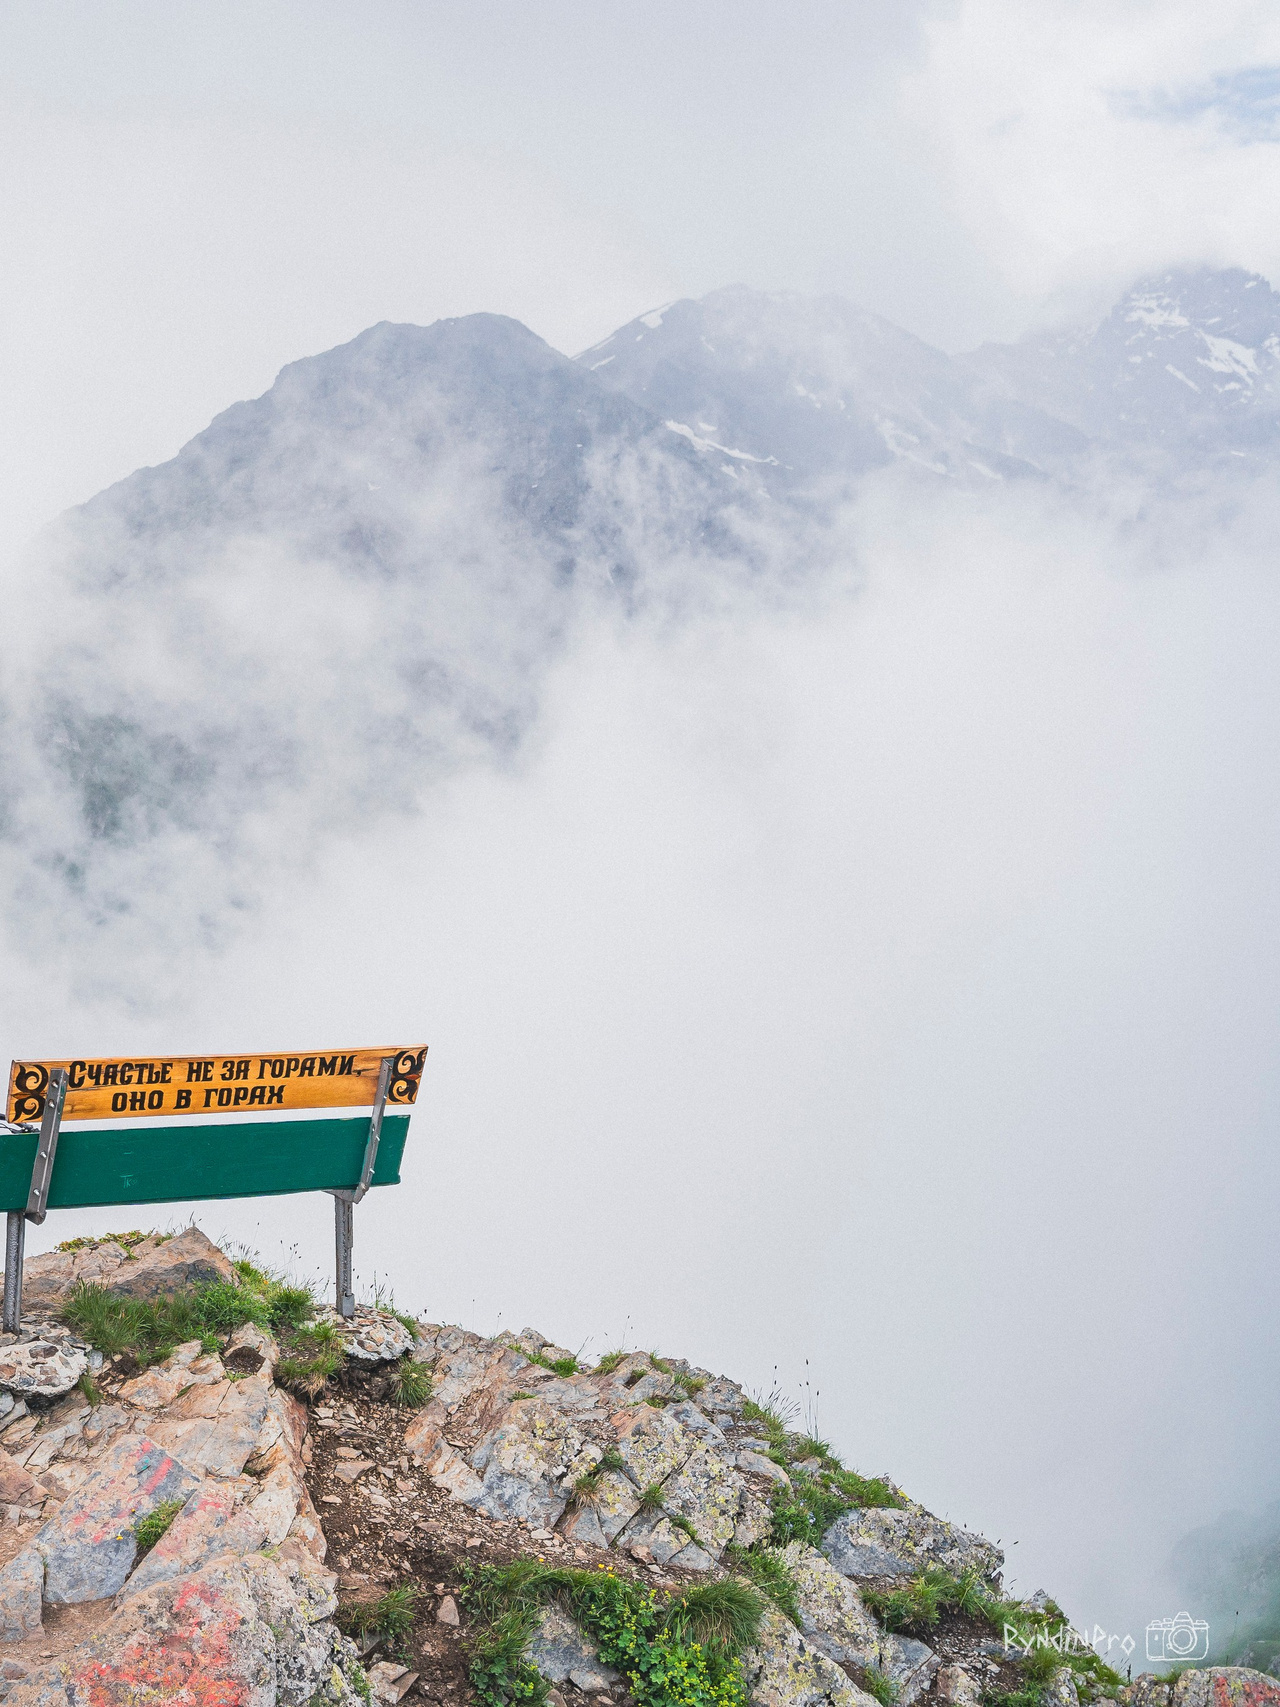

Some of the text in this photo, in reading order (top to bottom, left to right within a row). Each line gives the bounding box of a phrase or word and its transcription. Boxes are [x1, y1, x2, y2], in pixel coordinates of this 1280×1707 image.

[186, 1061, 214, 1082] НЕ
[220, 1059, 252, 1081] ЗА
[256, 1054, 362, 1080] ГОРАМИ,
[111, 1084, 286, 1112] ОНО В ГОРАХ
